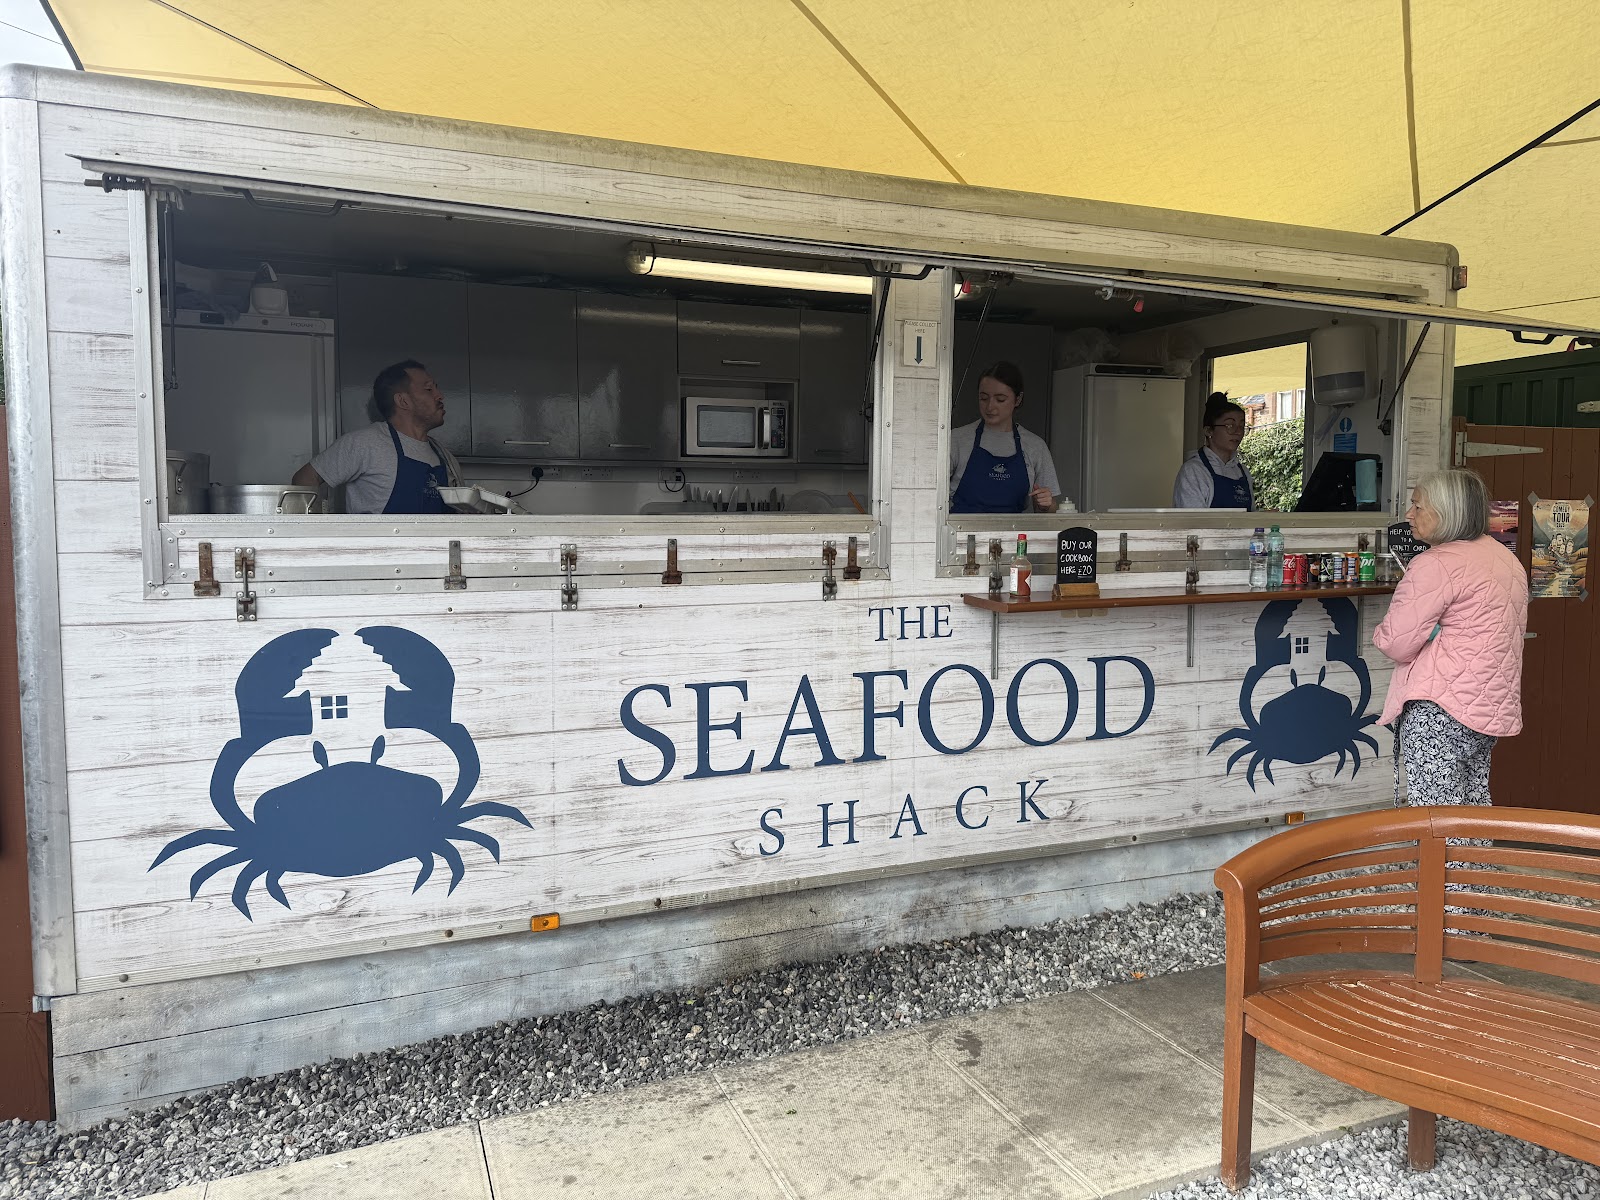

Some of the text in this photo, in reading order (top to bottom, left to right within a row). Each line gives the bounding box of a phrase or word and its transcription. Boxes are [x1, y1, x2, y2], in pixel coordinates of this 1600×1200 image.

[1142, 382, 1148, 392] 2
[1552, 505, 1571, 513] COMEDY
[1552, 512, 1571, 523] TOUR
[1389, 528, 1403, 536] HELP
[1061, 540, 1093, 551] BUY OUR
[1412, 544, 1427, 552] CARD
[1060, 553, 1094, 563] COOKBOOK
[1060, 565, 1093, 576] HERE £20
[868, 604, 953, 642] THE
[617, 655, 1155, 786] SEAFOOD
[758, 779, 1050, 856] SHACK
